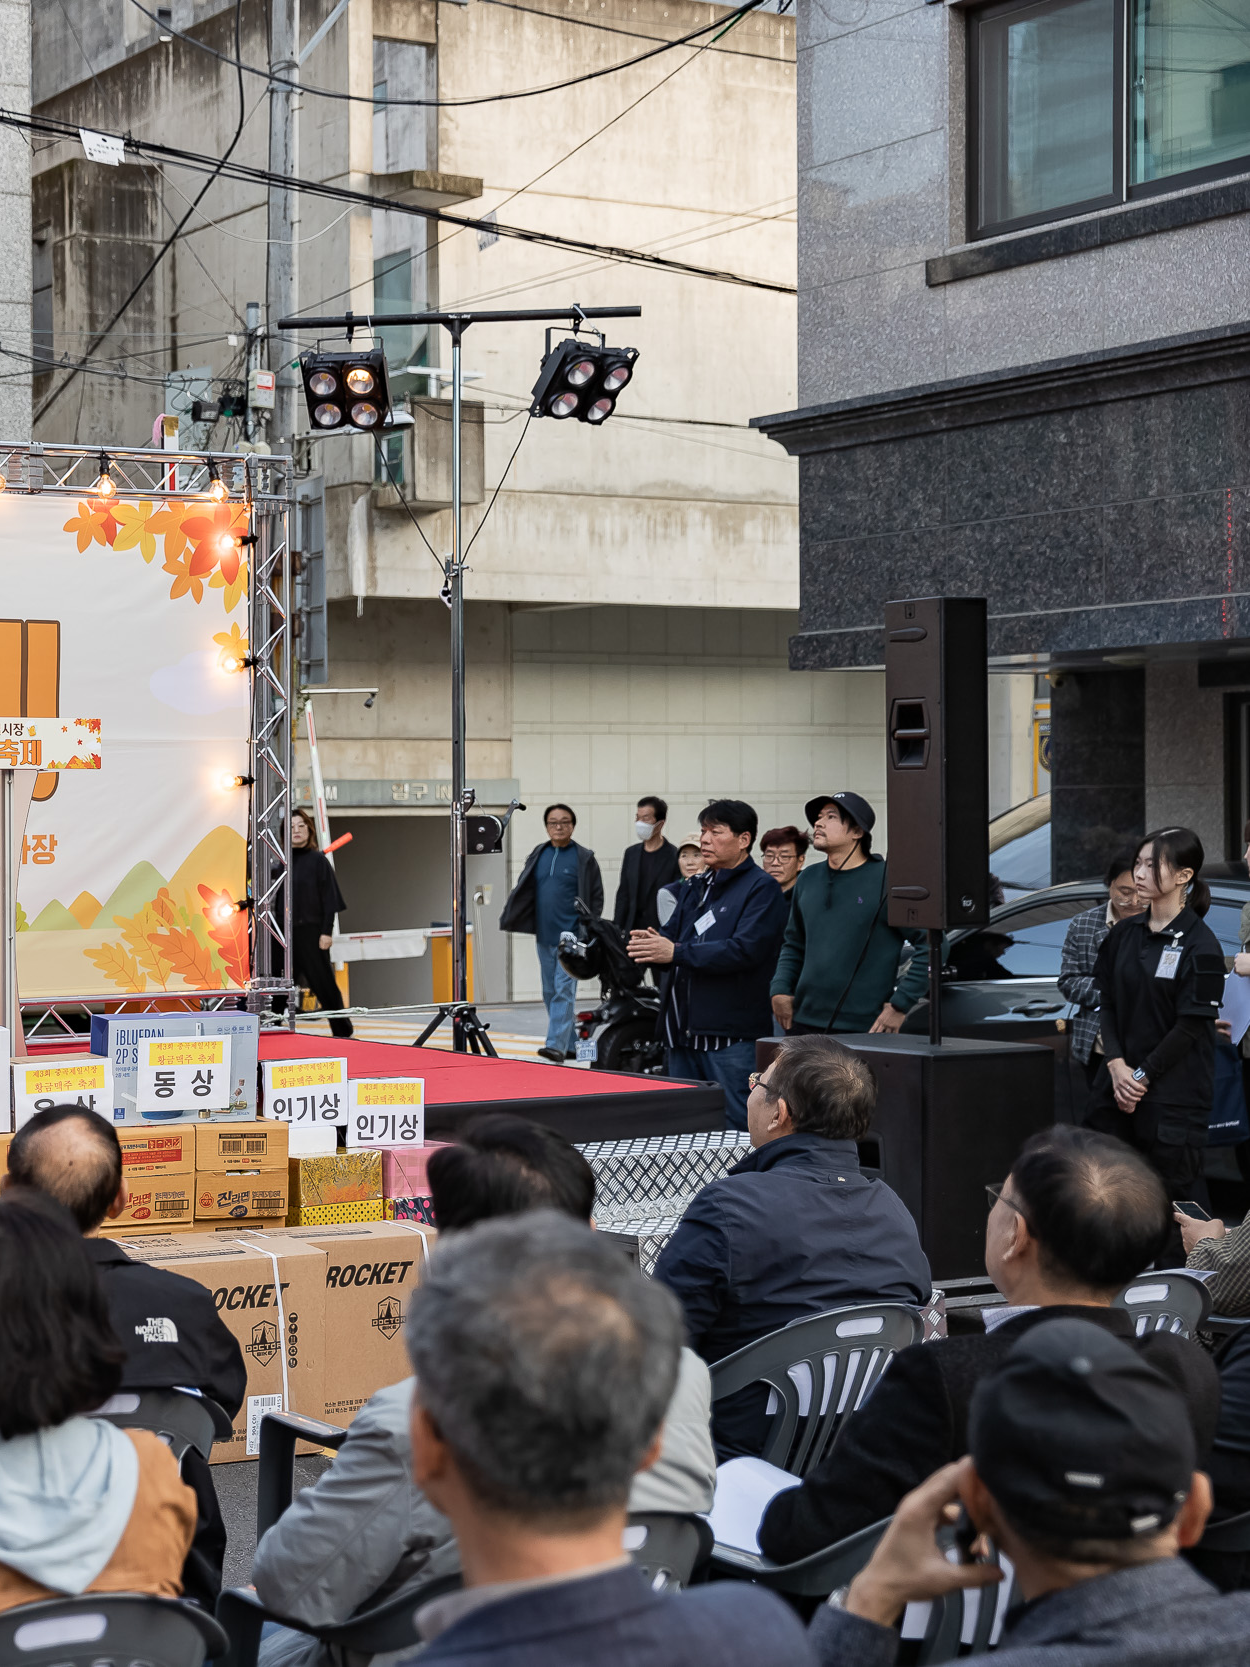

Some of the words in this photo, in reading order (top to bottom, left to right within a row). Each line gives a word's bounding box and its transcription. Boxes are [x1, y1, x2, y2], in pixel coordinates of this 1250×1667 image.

[391, 783, 429, 801] 입구
[177, 1041, 217, 1050] 중곡제일시장
[115, 1048, 129, 1065] 2P
[157, 1055, 193, 1065] 황금맥주
[198, 1053, 215, 1064] 축제
[32, 1070, 51, 1078] 제3회
[54, 1066, 98, 1077] 중곡제일시장
[277, 1064, 294, 1073] 제3회
[296, 1062, 335, 1072] 중곡제일시장
[34, 1081, 73, 1093] 황금맥주
[78, 1078, 97, 1089] 축제
[153, 1071, 176, 1098] 동
[190, 1069, 214, 1097] 상
[279, 1075, 314, 1088] 황금맥주
[317, 1074, 334, 1084] 축제
[363, 1083, 379, 1091] 제3회
[381, 1083, 416, 1091] 중곡제일시장
[364, 1095, 395, 1105] 황금맥주
[399, 1094, 415, 1104] 축제
[272, 1093, 340, 1123] 인기상
[356, 1114, 419, 1141] 인기상
[216, 1191, 250, 1209] 진라면
[325, 1260, 414, 1289] ROCKET
[146, 1317, 164, 1326] THE
[371, 1316, 406, 1327] DOCTOR
[134, 1325, 162, 1335] NORTH
[143, 1334, 164, 1342] FACE
